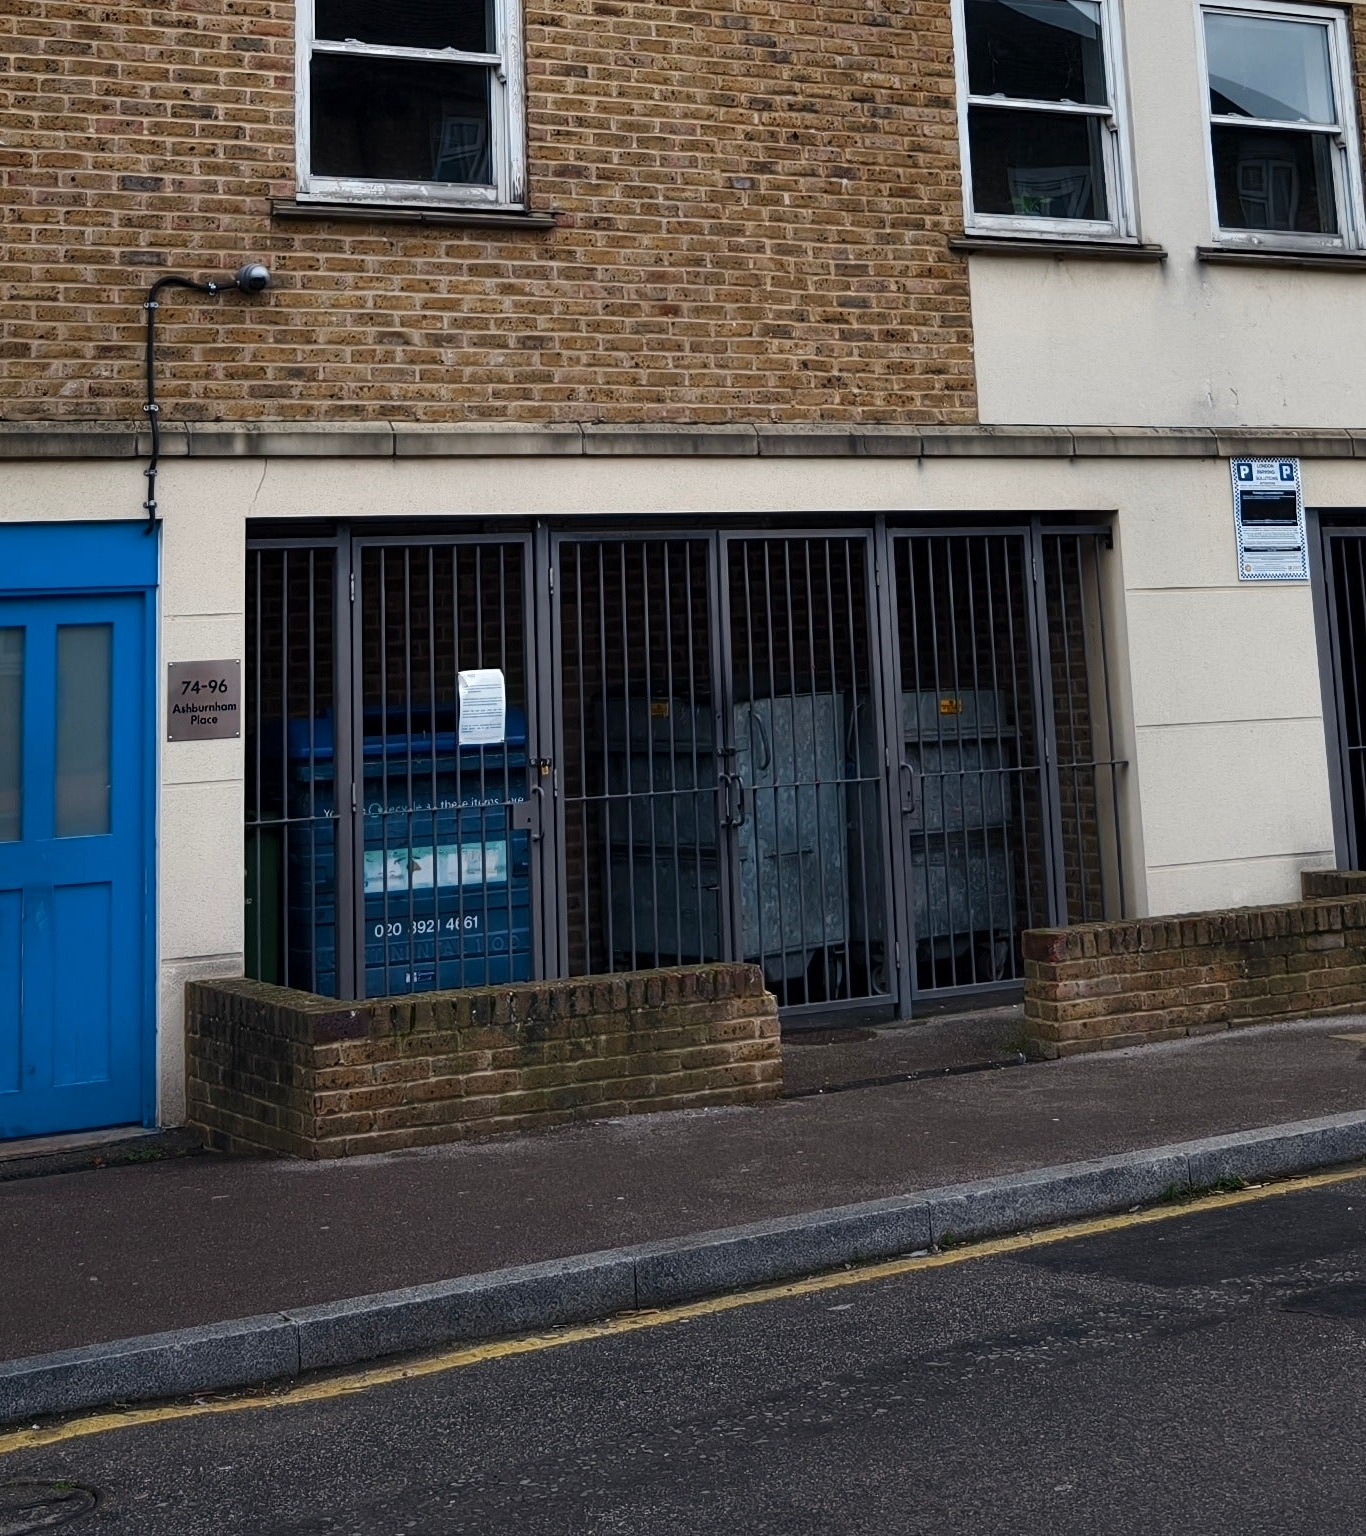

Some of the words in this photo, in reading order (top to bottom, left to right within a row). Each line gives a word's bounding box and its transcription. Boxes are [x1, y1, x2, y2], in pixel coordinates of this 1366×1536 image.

[1239, 465, 1250, 479] P
[1281, 465, 1291, 479] P
[181, 678, 228, 695] 74-96
[172, 701, 237, 714] Ashburnham
[190, 714, 218, 725] Place
[374, 922, 402, 938] 020
